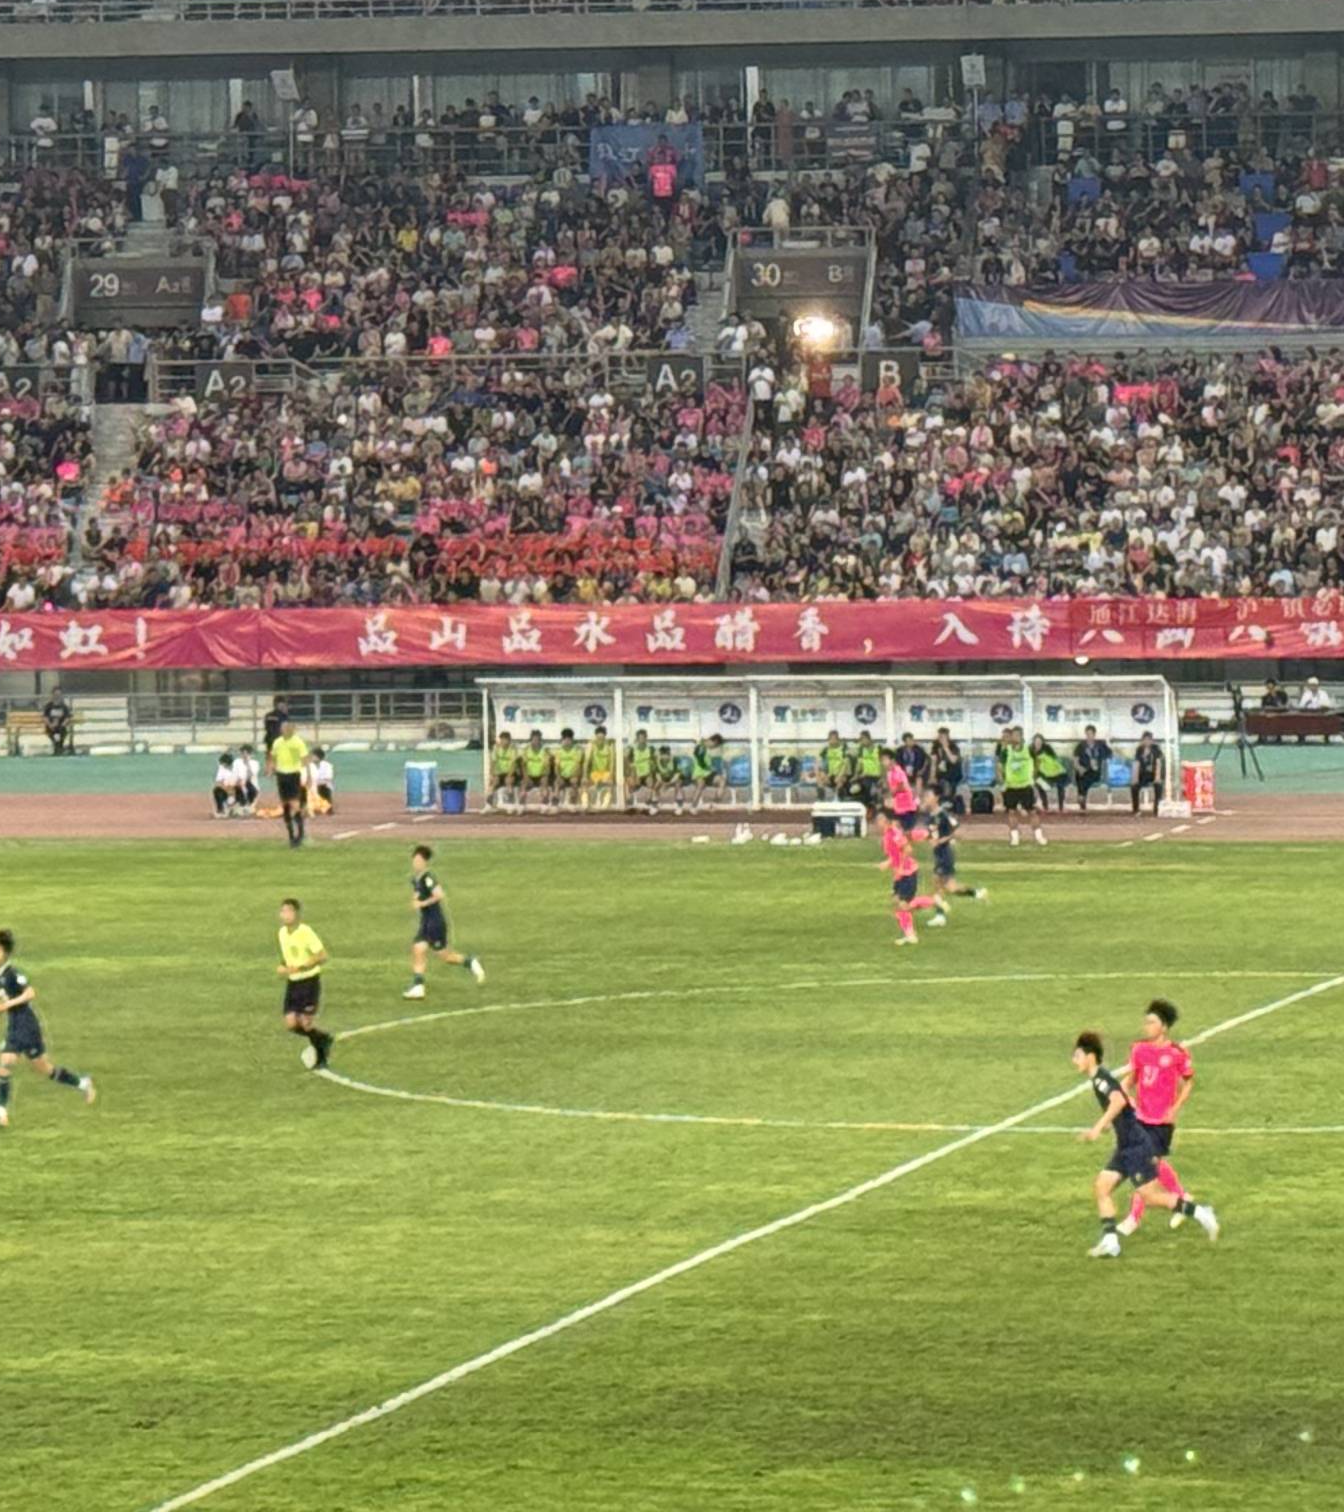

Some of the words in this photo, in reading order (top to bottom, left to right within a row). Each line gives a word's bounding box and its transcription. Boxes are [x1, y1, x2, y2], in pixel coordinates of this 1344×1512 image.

[89, 273, 119, 297] 29
[751, 263, 781, 288] 30
[205, 369, 246, 398] A2
[655, 364, 697, 394] A2
[878, 360, 902, 388] B
